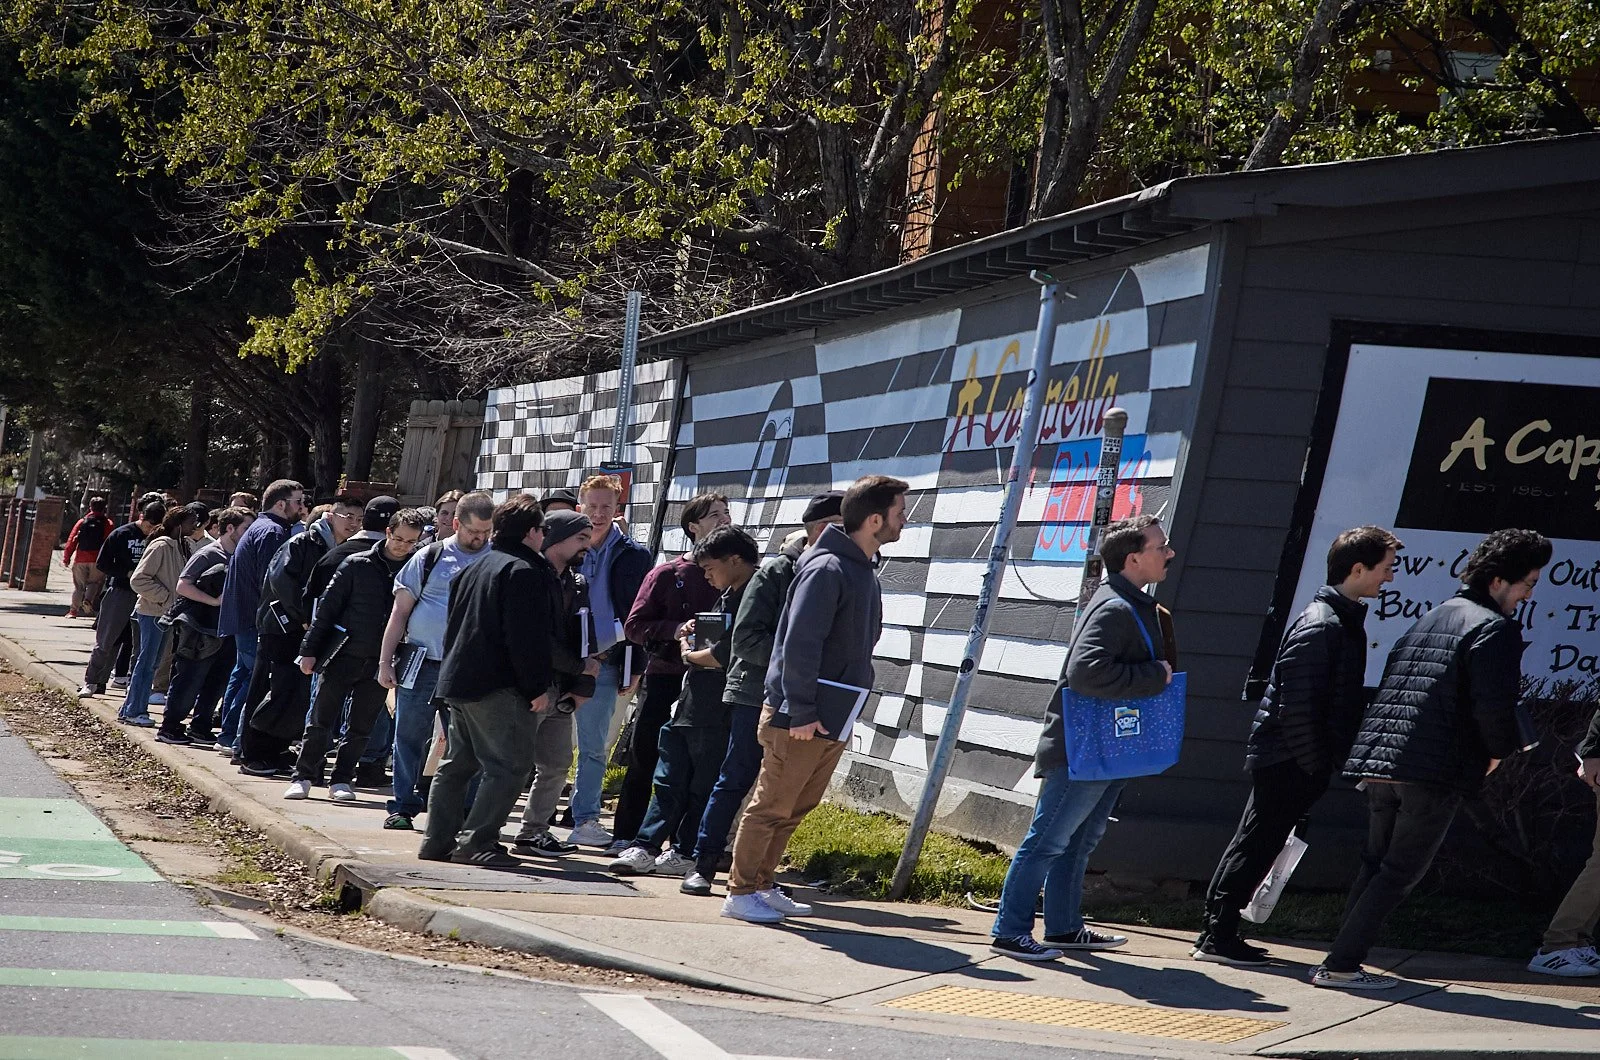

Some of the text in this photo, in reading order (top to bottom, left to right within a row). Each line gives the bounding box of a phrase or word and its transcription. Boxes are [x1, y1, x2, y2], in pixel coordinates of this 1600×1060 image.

[946, 319, 1119, 497] A Capella
[1440, 416, 1600, 481] A Cap
[128, 539, 147, 549] PLA
[1392, 554, 1433, 577] ew
[1549, 643, 1600, 675] Da
